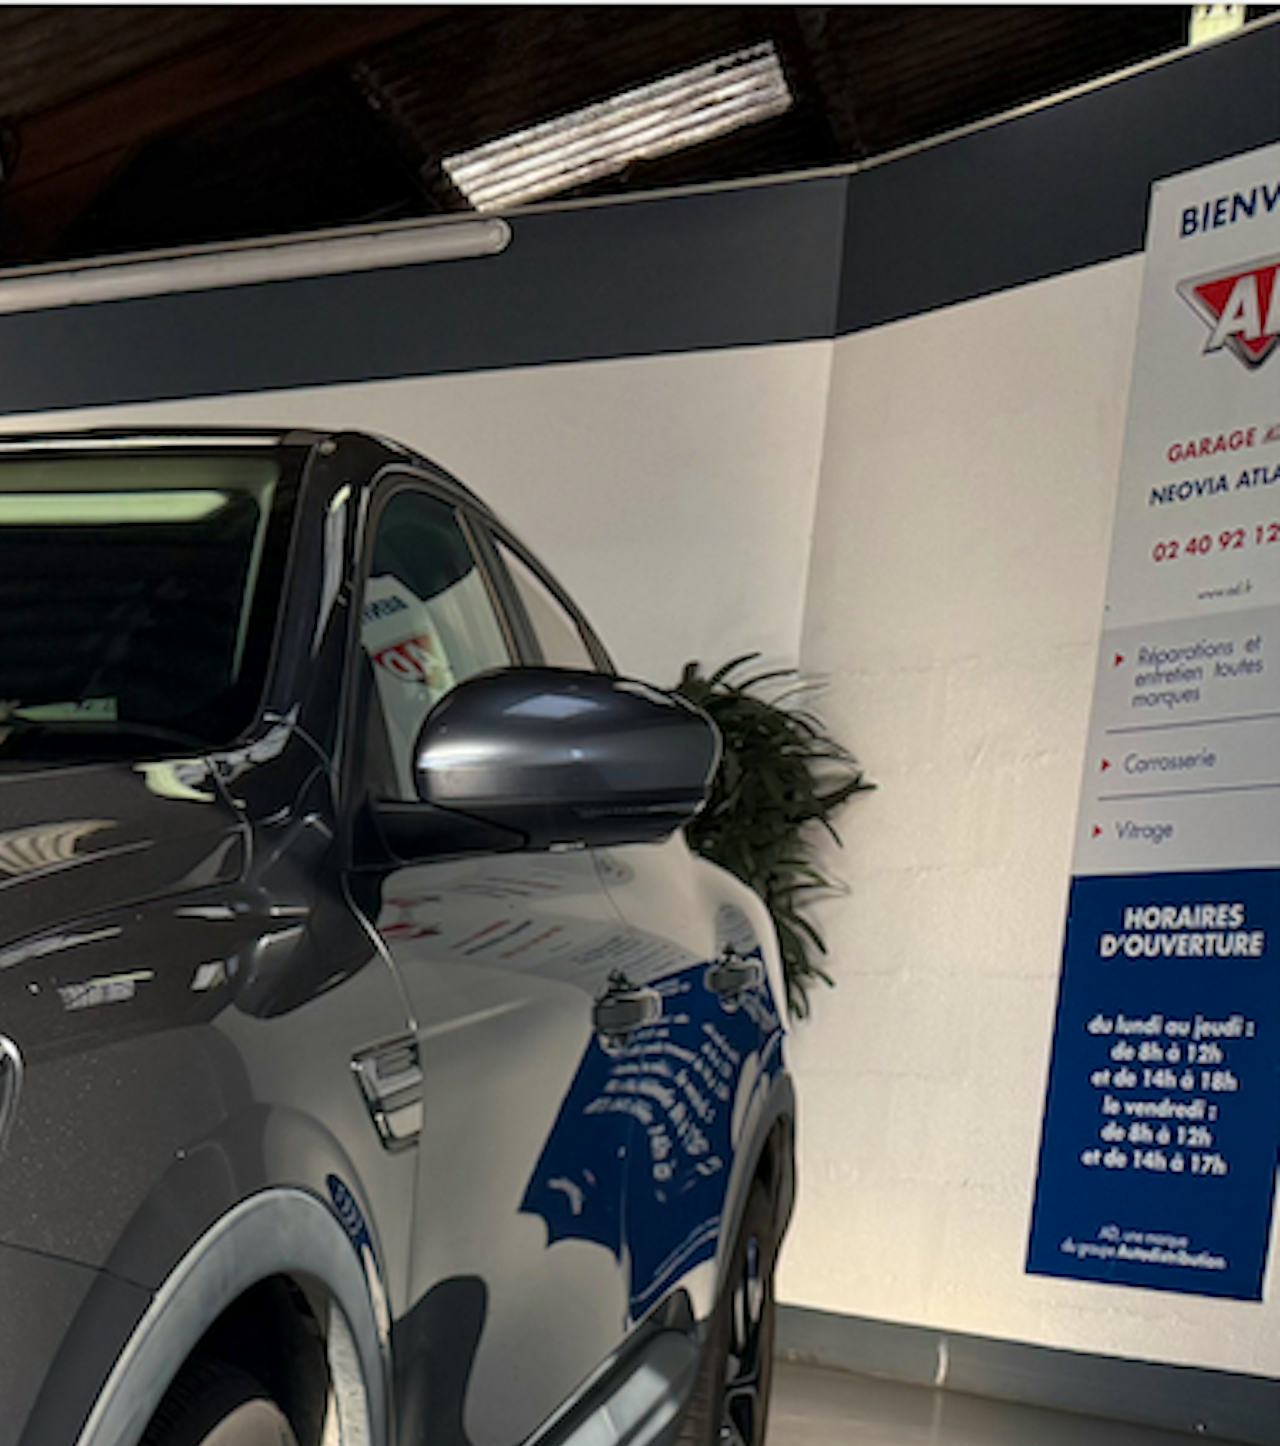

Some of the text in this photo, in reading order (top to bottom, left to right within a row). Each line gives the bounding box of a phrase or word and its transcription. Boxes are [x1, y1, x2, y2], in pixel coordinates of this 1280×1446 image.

[1167, 427, 1257, 463] GARAGE
[1149, 475, 1228, 505] NEOVIA
[1152, 542, 1179, 562] 02
[1185, 534, 1212, 555] 40
[1218, 528, 1246, 549] 92
[1137, 635, 1261, 667] Réparations et
[1134, 659, 1264, 687] entretien toutes
[1131, 688, 1200, 709] marques
[1124, 747, 1216, 774] Carrosserie
[1115, 821, 1174, 844] Vitrage
[1123, 904, 1245, 930] HORAIRES
[1087, 1014, 1113, 1035] du
[1115, 1014, 1163, 1036] lundi
[1165, 1020, 1190, 1036] au
[1192, 1015, 1243, 1040] jeudi
[1111, 1041, 1135, 1061] de
[1187, 1043, 1223, 1064] 12h
[1090, 1070, 1112, 1088] et
[1113, 1068, 1137, 1088] de
[1143, 1069, 1177, 1089] 14h
[1102, 1095, 1121, 1115] le
[1124, 1097, 1207, 1120] vendredi
[1101, 1122, 1125, 1142] de
[1177, 1126, 1212, 1147] 12h
[1081, 1149, 1102, 1165] et
[1103, 1148, 1128, 1168] de
[1133, 1149, 1167, 1171] 14h
[1191, 1153, 1228, 1175] 17h
